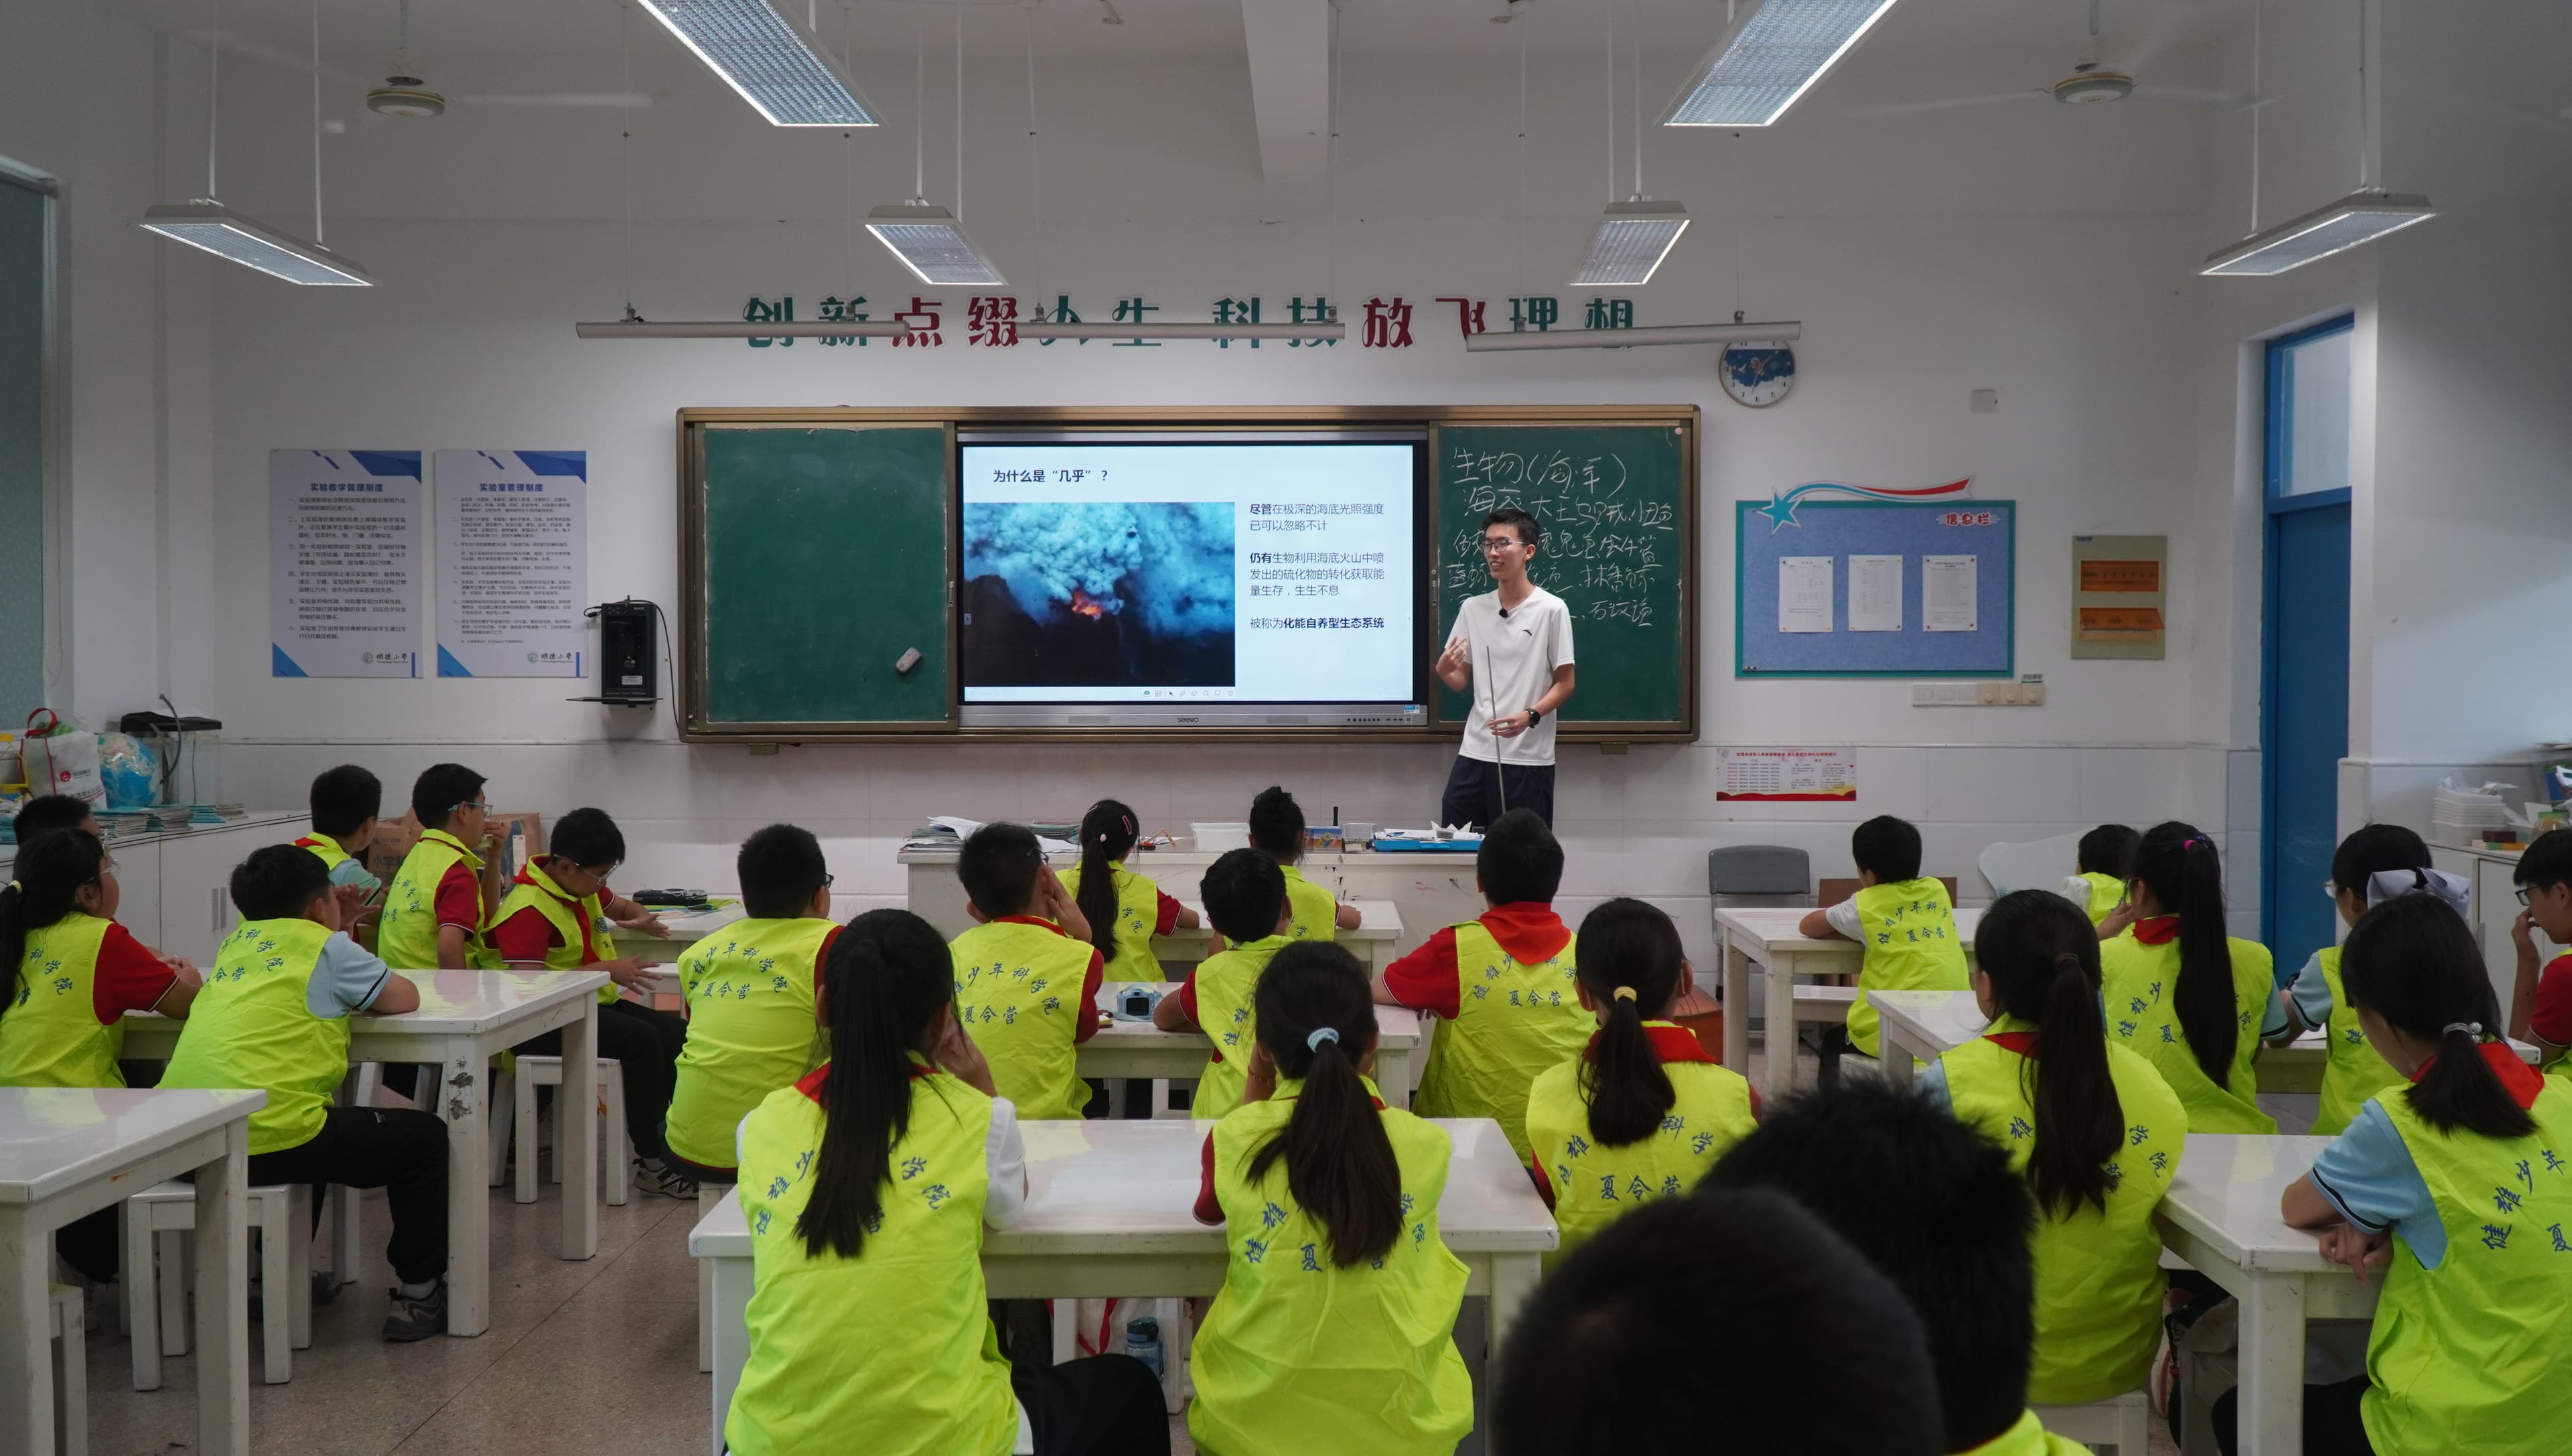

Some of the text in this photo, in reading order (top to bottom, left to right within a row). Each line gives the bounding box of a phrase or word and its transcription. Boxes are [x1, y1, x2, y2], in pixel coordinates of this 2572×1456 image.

[742, 295, 1162, 348] 创新点缀人生
[310, 483, 384, 492] 实验教学管理制度
[479, 483, 545, 492] 实验室管理制度
[1249, 503, 1385, 516] 尽管在极深的海底光照强度
[1945, 512, 1992, 526] 信息栏
[1250, 520, 1328, 532] 已可以忽略不计
[1249, 552, 1385, 565] 仍有生物利用海底火山中喷
[1249, 568, 1385, 581] 发出的硫化物的转化获取能
[1250, 585, 1340, 597] 量生存，生生不息
[1250, 617, 1385, 630] 被称为化能自养型生态系统
[703, 981, 751, 1000] 夏令营
[1508, 989, 1562, 1008] 夏令营
[964, 1005, 1017, 1025] 夏令营
